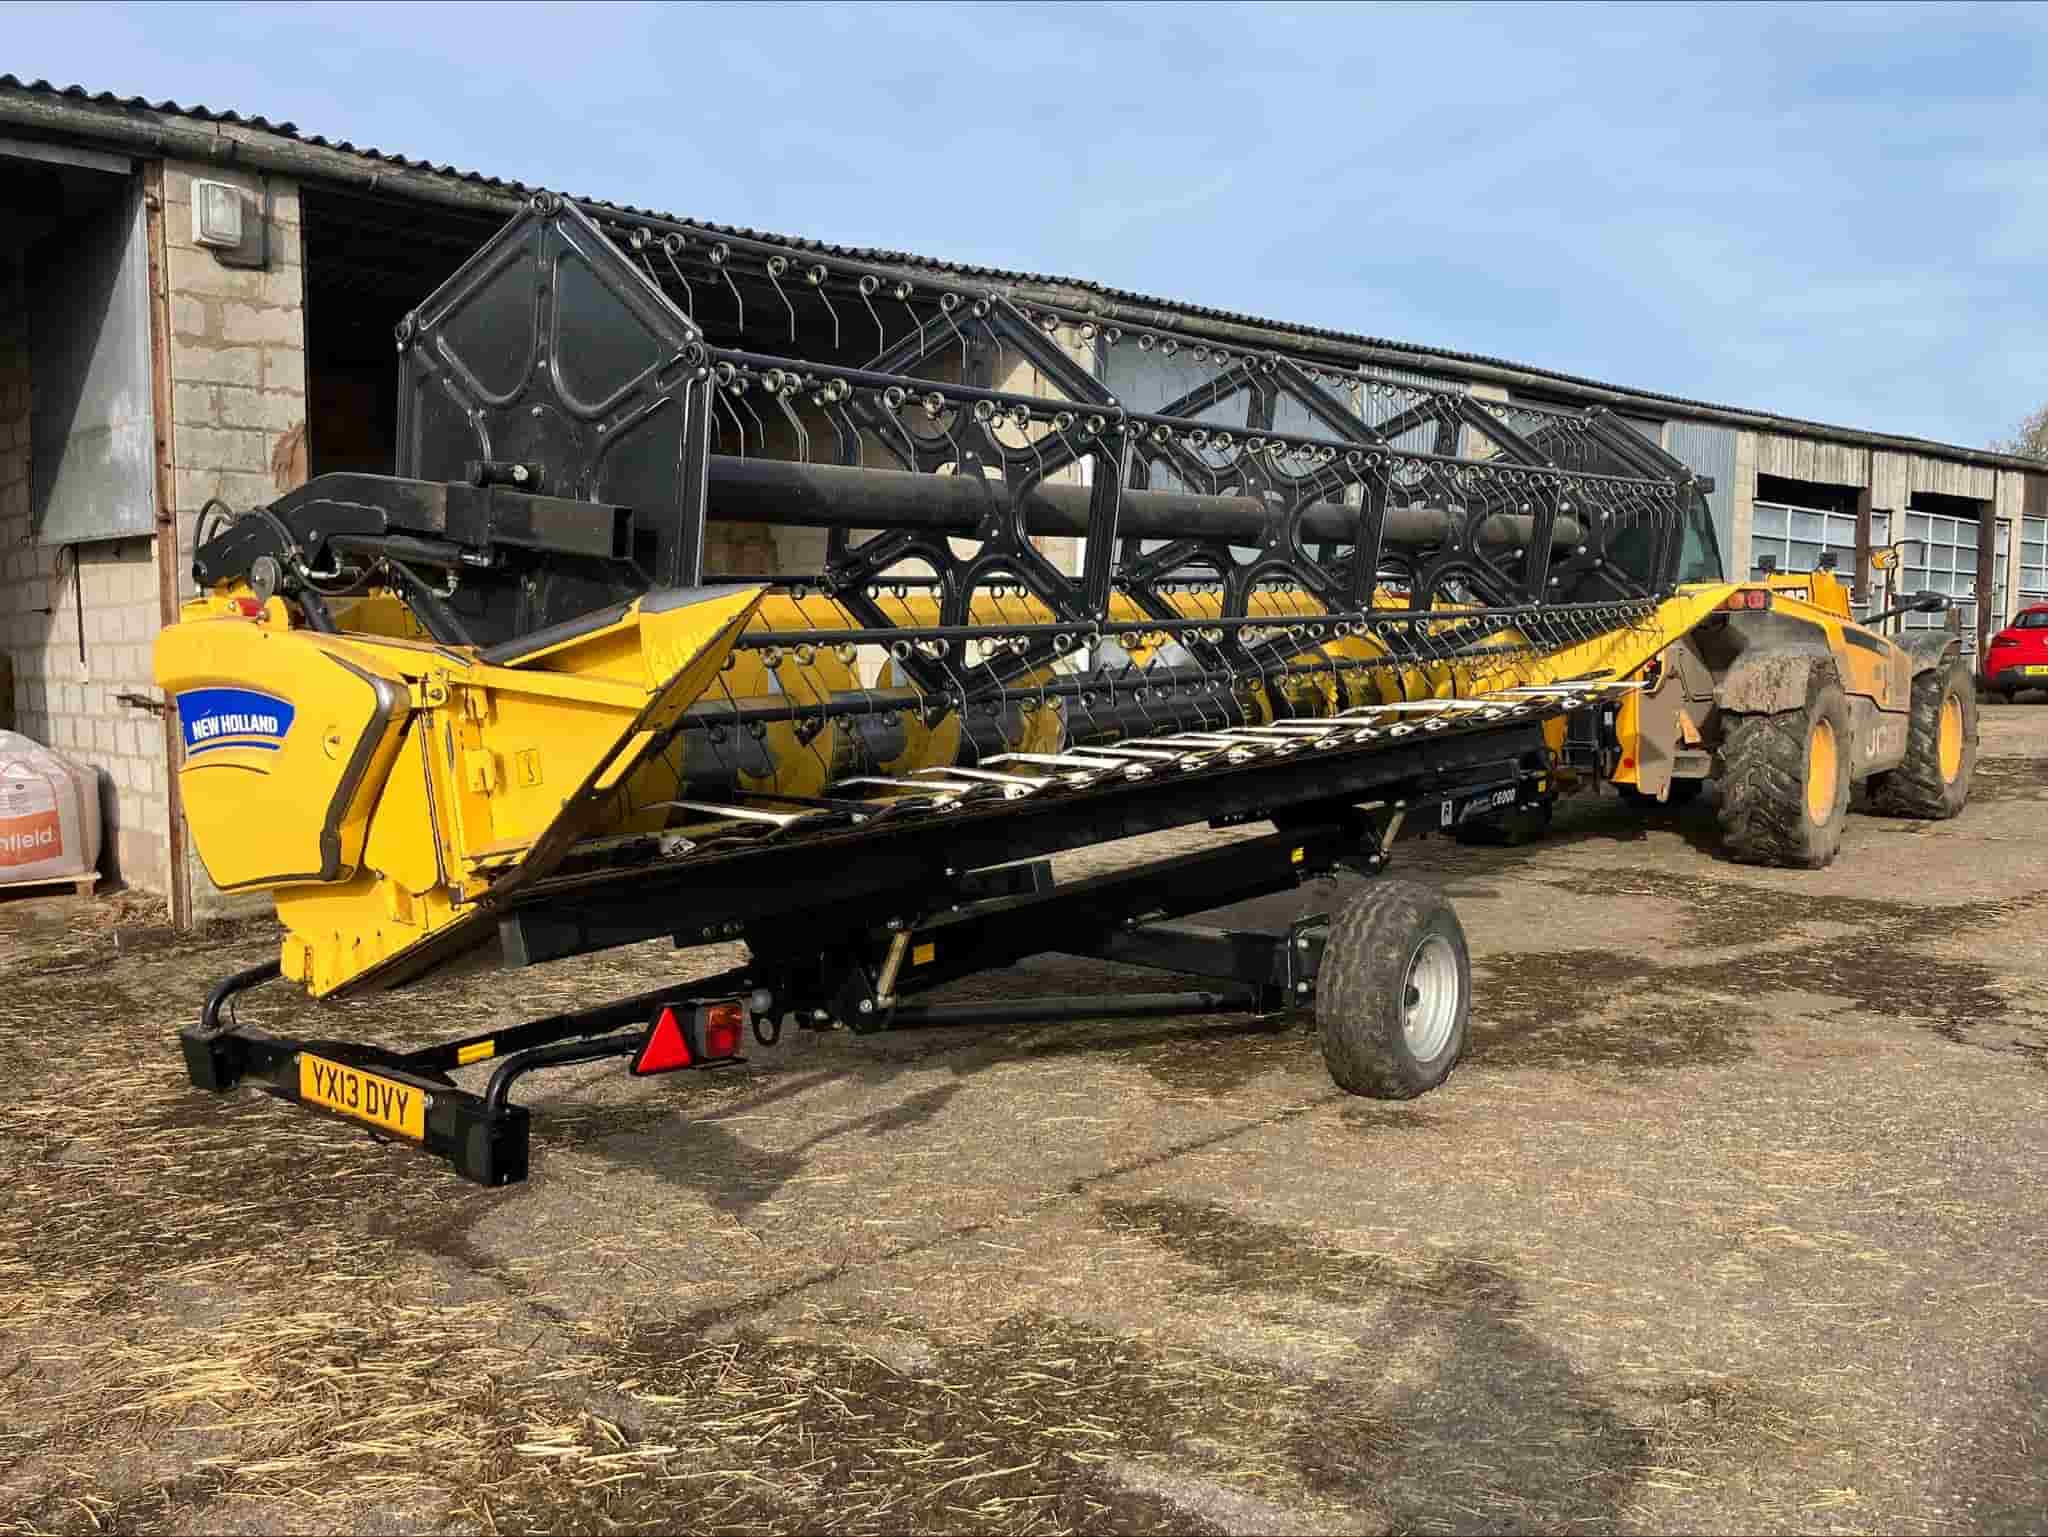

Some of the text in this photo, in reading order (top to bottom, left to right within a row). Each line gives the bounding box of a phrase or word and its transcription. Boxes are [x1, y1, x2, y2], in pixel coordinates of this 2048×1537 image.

[192, 713, 279, 740] NEW HOLLAND
[312, 1060, 409, 1126] YX13 DVY
